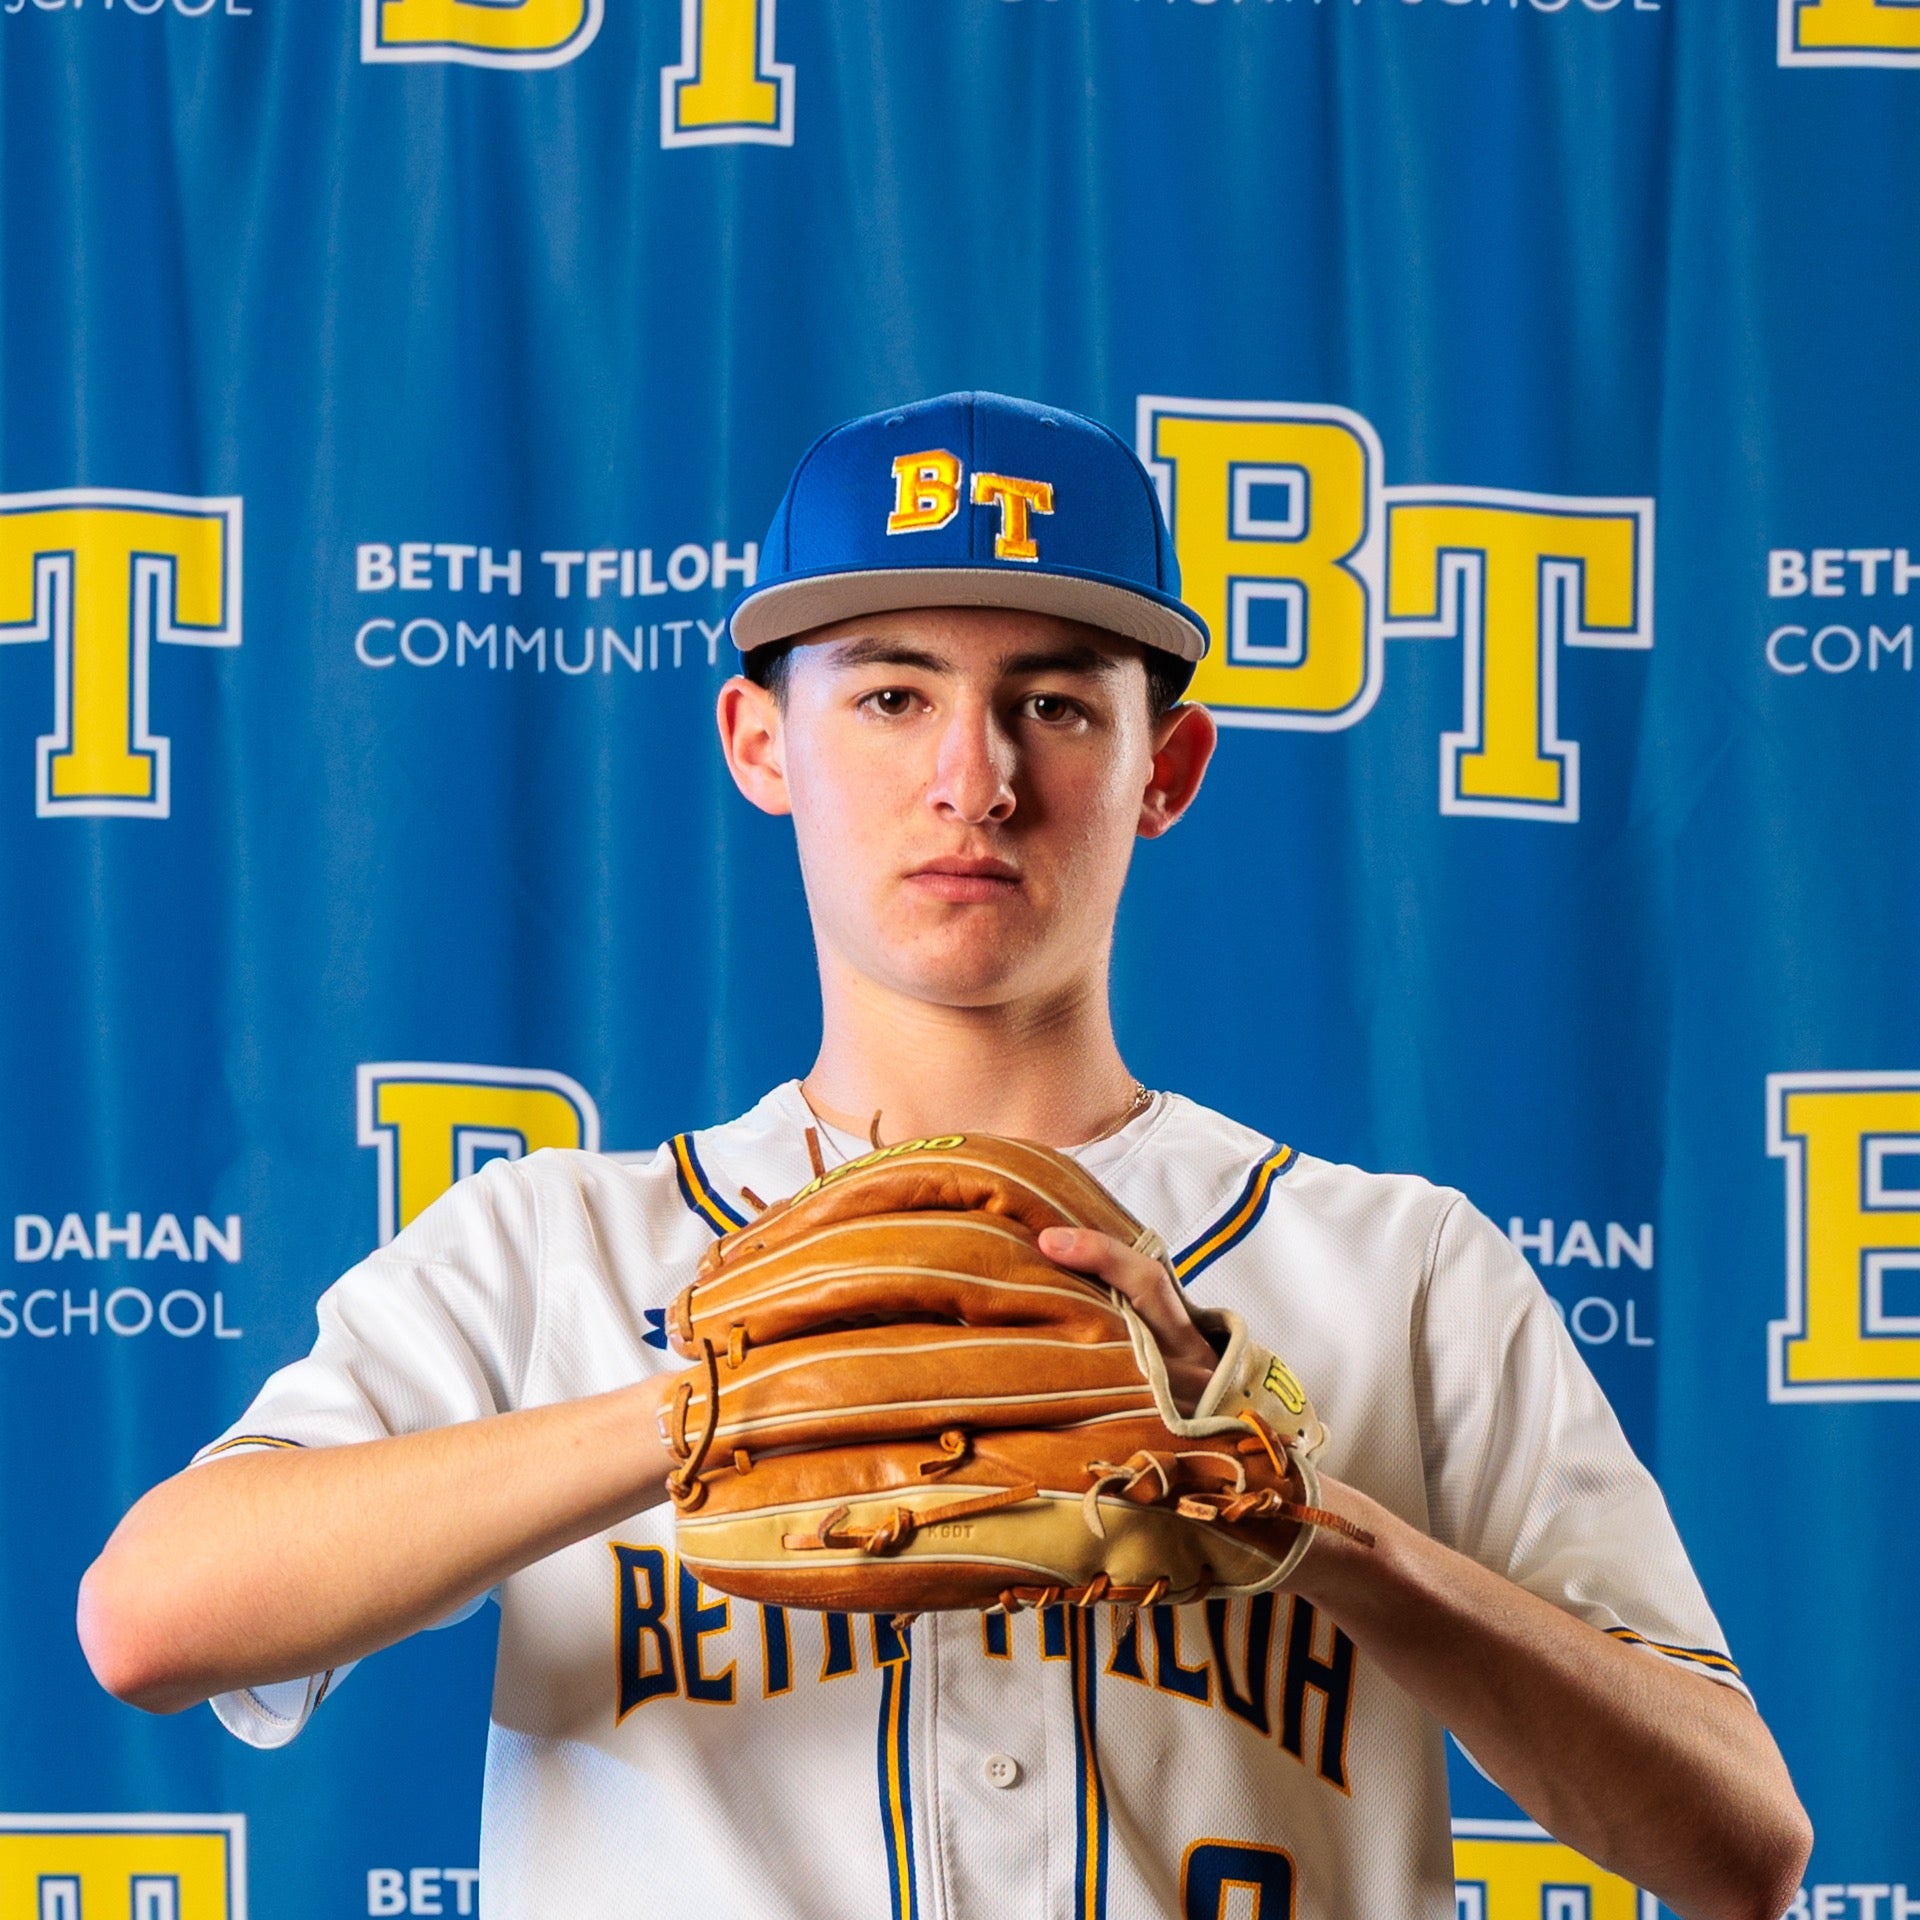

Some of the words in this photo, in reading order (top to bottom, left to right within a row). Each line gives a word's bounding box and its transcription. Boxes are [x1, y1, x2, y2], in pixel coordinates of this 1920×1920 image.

[886, 448, 1055, 563] BT
[356, 543, 522, 596] BETH
[540, 541, 759, 598] TFILOH
[1136, 395, 1655, 822] BT
[355, 618, 726, 675] COMMUNITY
[1766, 624, 1914, 675] COM
[14, 1213, 242, 1264] DAHAN
[0, 1288, 243, 1339] SCHOOL
